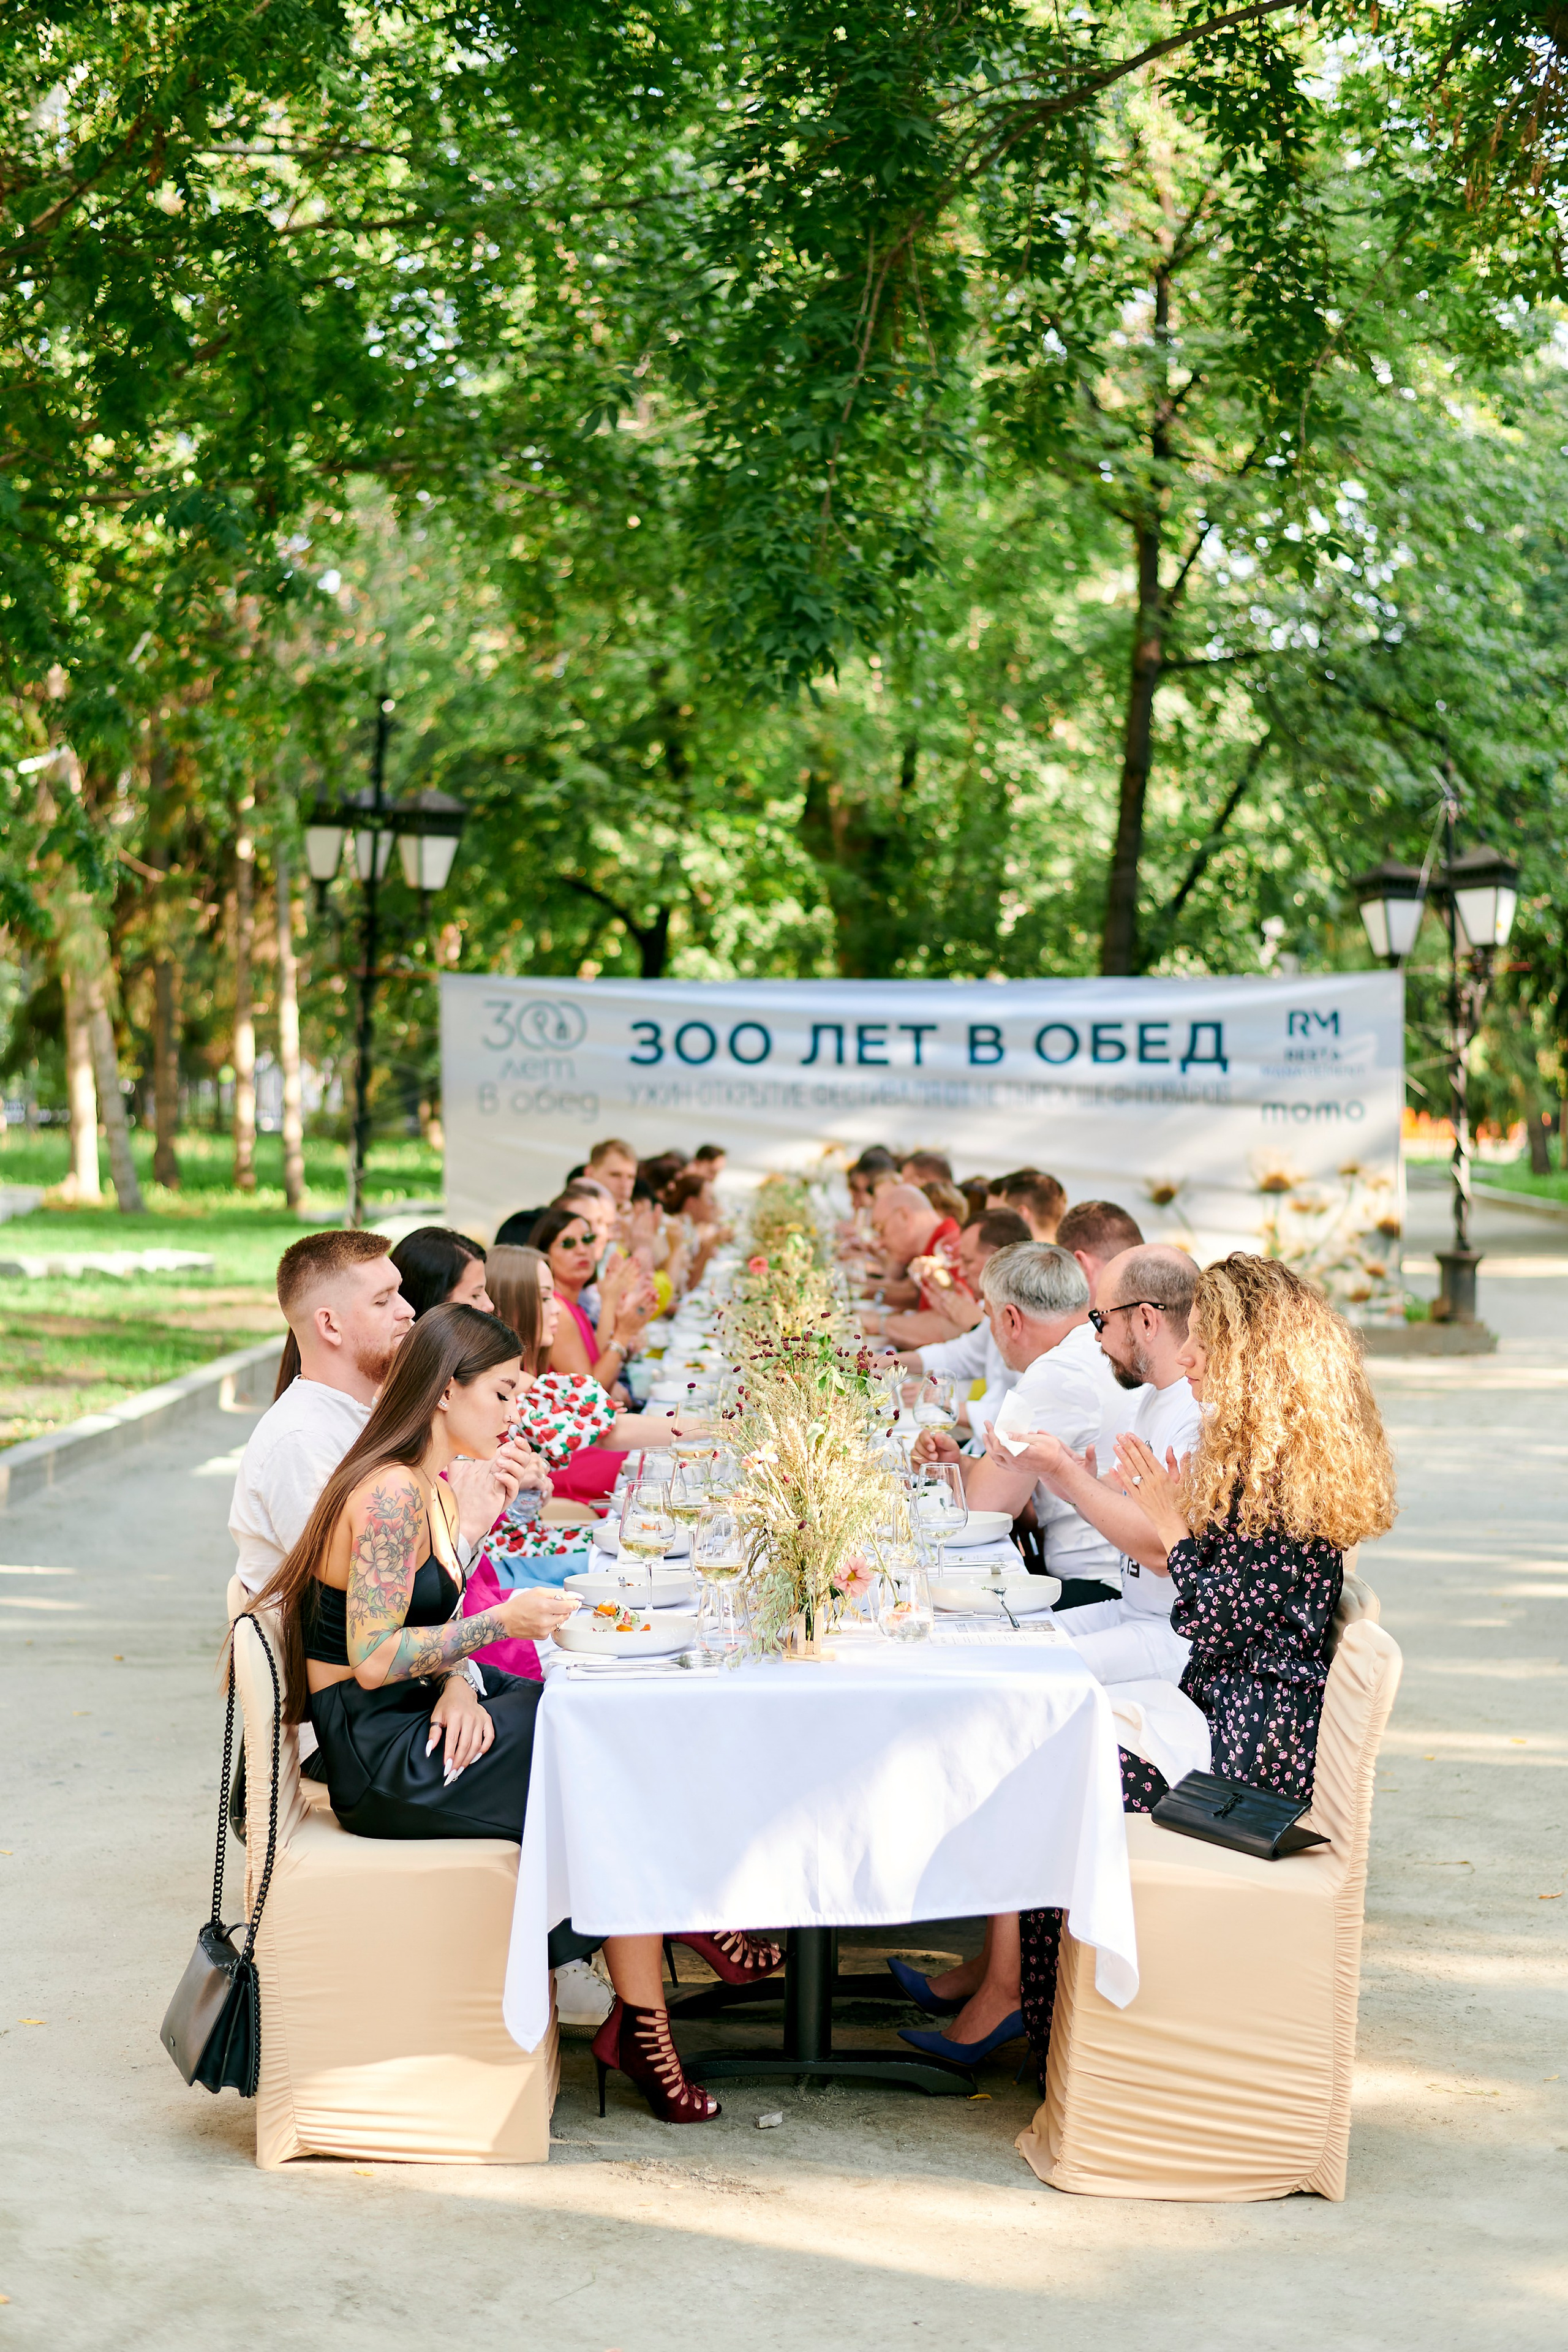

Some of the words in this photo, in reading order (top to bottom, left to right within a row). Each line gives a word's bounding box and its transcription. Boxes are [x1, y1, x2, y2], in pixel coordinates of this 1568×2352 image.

[1287, 1009, 1341, 1037] RM
[628, 1020, 772, 1066] 300
[799, 1023, 937, 1066] ЛЕТ
[968, 1023, 1005, 1065] В
[1034, 1022, 1228, 1073] ОБЕД
